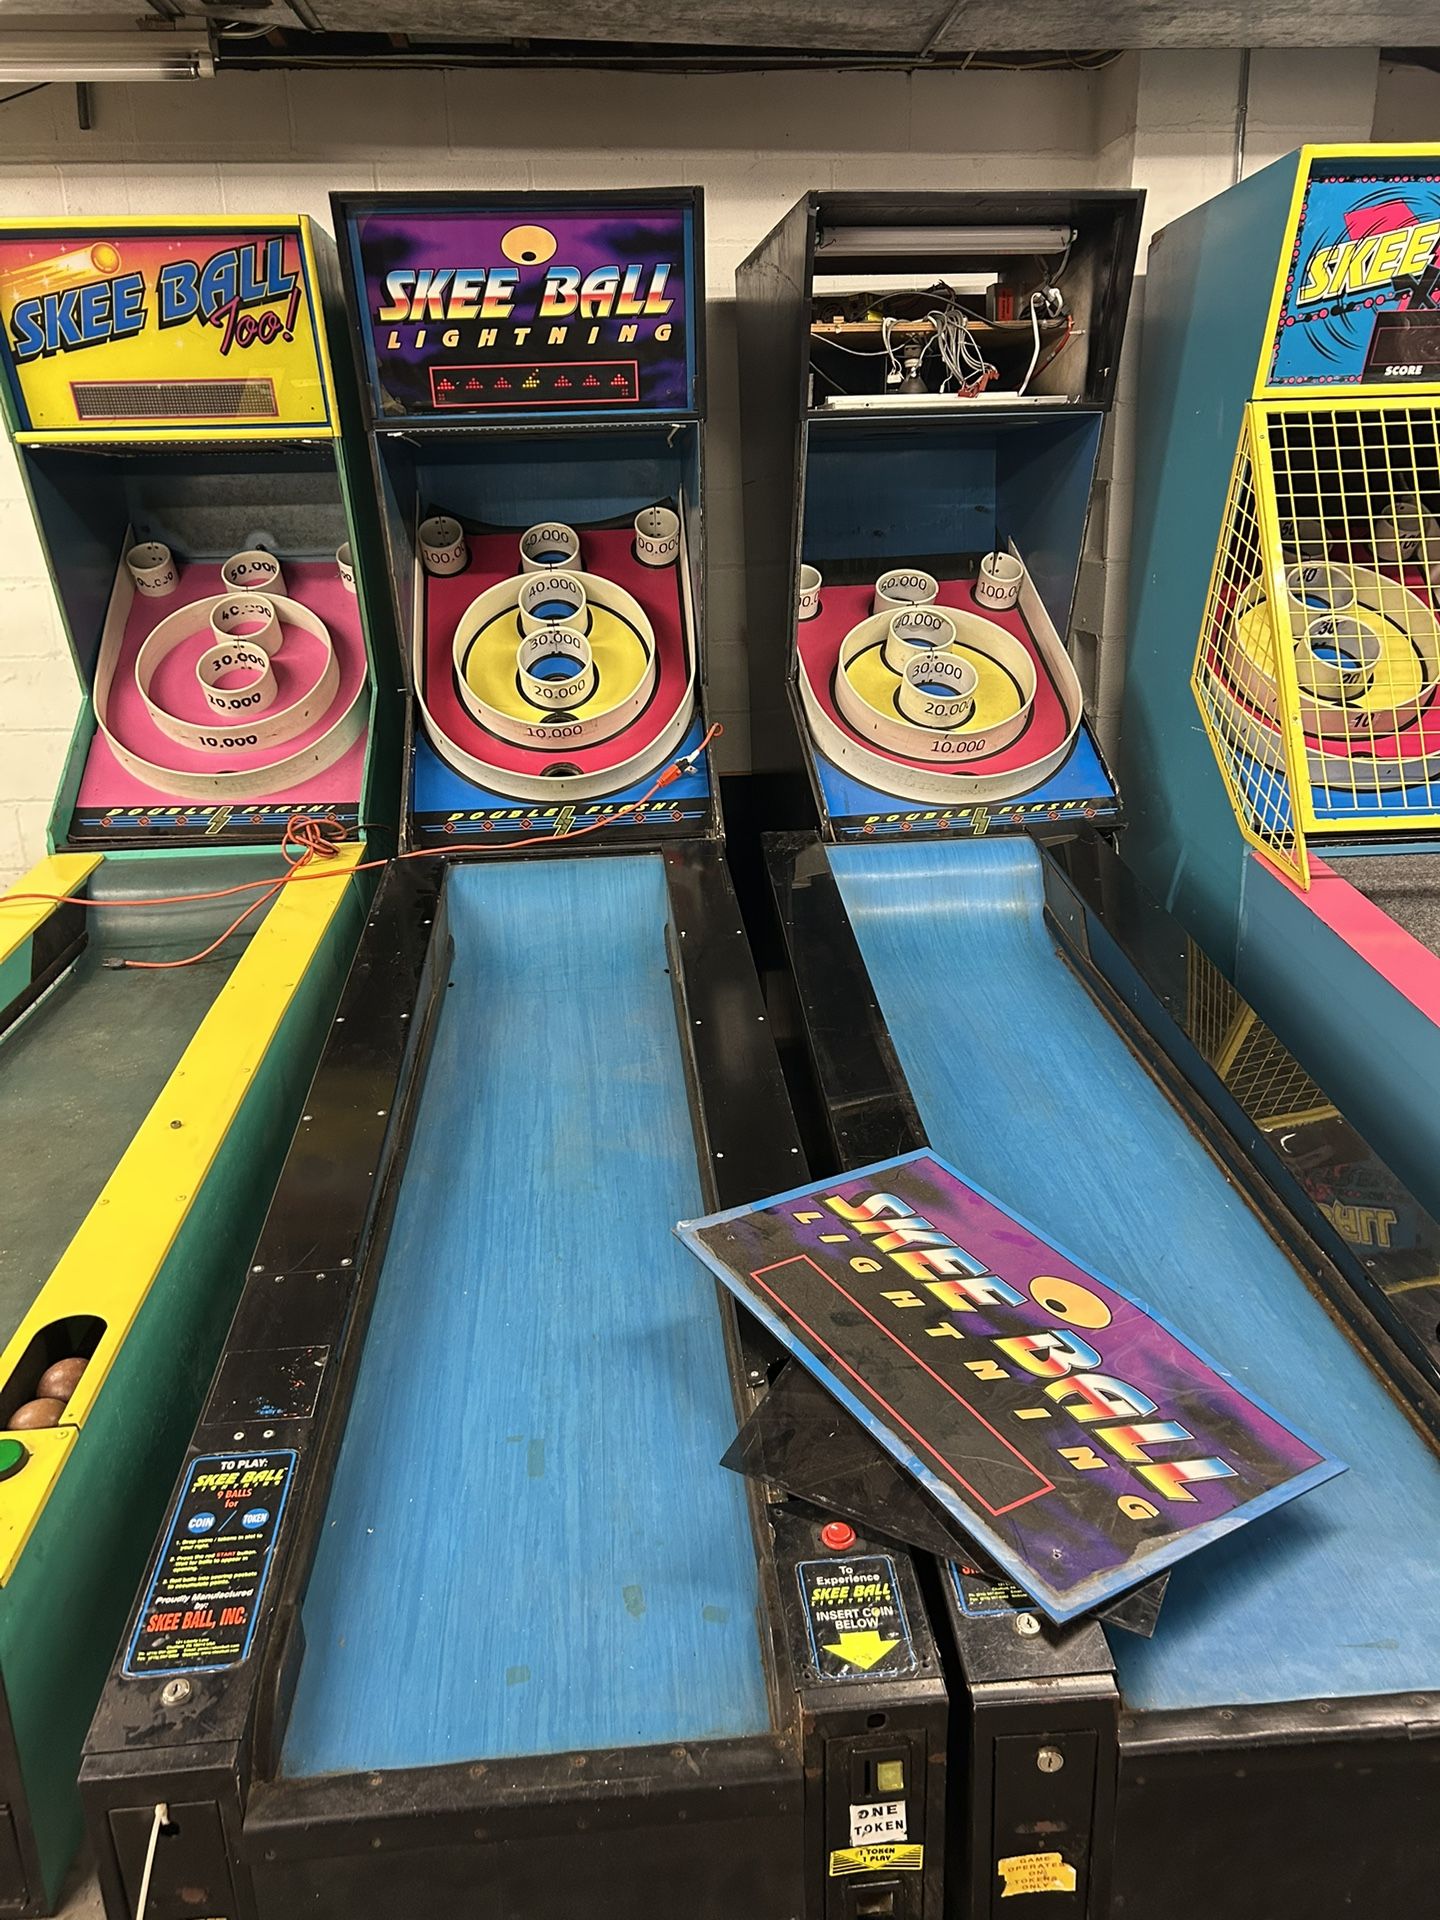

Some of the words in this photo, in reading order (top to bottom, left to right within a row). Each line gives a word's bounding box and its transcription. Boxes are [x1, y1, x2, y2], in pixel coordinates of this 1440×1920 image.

[1297, 220, 1440, 304] SKEE
[12, 272, 147, 362] SKEE
[158, 236, 298, 327] BALL
[378, 267, 521, 322] SKEE
[538, 263, 675, 319] BALL
[210, 287, 301, 356] Too!
[387, 322, 673, 349] LIGHTNING
[1384, 365, 1424, 377] SCORE
[231, 561, 278, 580] 50.000
[529, 578, 577, 599] 40.000
[881, 576, 927, 592] 50.000
[981, 581, 1021, 600] 100.0
[530, 633, 582, 650] 30.000
[213, 652, 266, 672] 30.000
[912, 662, 963, 680] 30.000
[533, 679, 586, 700] 20.000
[526, 724, 583, 739] 10.000
[199, 734, 258, 748] 10.000
[931, 739, 986, 753] 10.000
[106, 807, 218, 817] DOUBLE
[242, 804, 336, 814] FLASH!
[448, 807, 559, 821] DOUBLE
[865, 808, 971, 824] DOUBLE
[999, 801, 1088, 815] FLASH!
[822, 1191, 1029, 1314] SKEE
[992, 1328, 1239, 1504] BALL
[795, 1211, 1161, 1521] LIGHTNING
[221, 1460, 236, 1471] TO
[237, 1458, 269, 1470] PLAY:
[193, 1472, 240, 1488] SKEE
[240, 1468, 284, 1485] BALL
[217, 1491, 224, 1499] 9
[225, 1488, 252, 1498] BALLS
[225, 1499, 239, 1508] for
[187, 1517, 215, 1529] COIN
[242, 1513, 268, 1525] TOKEN
[838, 1565, 853, 1575] To
[816, 1574, 880, 1586] Experience
[155, 1594, 191, 1604] Proudly
[191, 1588, 254, 1602] Manufactured
[811, 1586, 850, 1601] SKEE
[853, 1583, 891, 1598] BALL
[193, 1602, 209, 1610] by:
[816, 1608, 860, 1622] INSERT
[863, 1605, 894, 1618] COIN
[146, 1612, 182, 1633] SKEE
[181, 1609, 216, 1630] BALL,
[219, 1606, 246, 1626] INC.
[835, 1616, 879, 1630] BELOW
[857, 1804, 898, 1820] ONE
[854, 1819, 904, 1836] TOKEN
[865, 1847, 896, 1855] TOKEN
[870, 1854, 891, 1862] PLAY
[1019, 1856, 1050, 1864] GAME
[1021, 1882, 1049, 1890] ONLY
